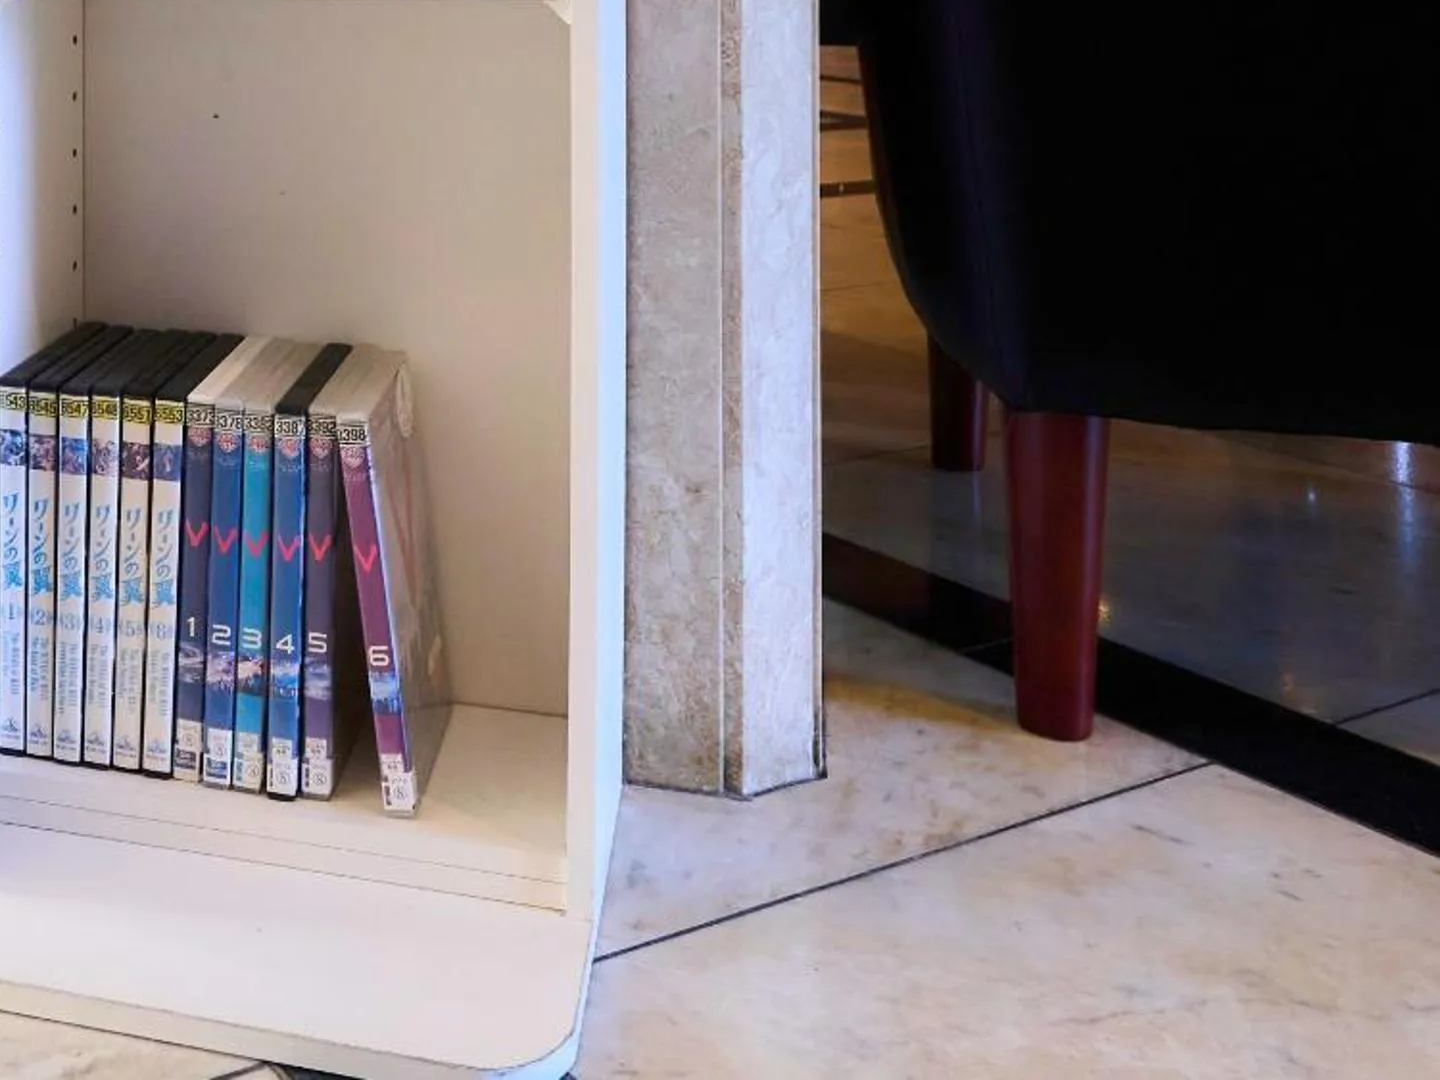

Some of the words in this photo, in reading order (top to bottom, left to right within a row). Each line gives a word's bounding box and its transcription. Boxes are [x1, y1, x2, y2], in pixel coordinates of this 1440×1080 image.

[2, 491, 22, 591] リーンの翼
[32, 497, 51, 596] リーンの翼
[185, 519, 209, 547] V
[214, 525, 239, 554] V
[245, 531, 269, 558] V
[277, 533, 302, 561] V
[308, 533, 332, 561] V
[60, 502, 82, 601] リーンの翼
[91, 504, 114, 602] リーンの翼
[120, 508, 144, 605] リーンの翼
[151, 509, 175, 608] リーンの翼
[354, 545, 377, 572] V
[186, 616, 195, 637] 1
[212, 624, 231, 646] 2
[242, 628, 262, 649] 3
[276, 634, 295, 654] 4
[308, 631, 327, 653] 5
[368, 645, 389, 667] 6
